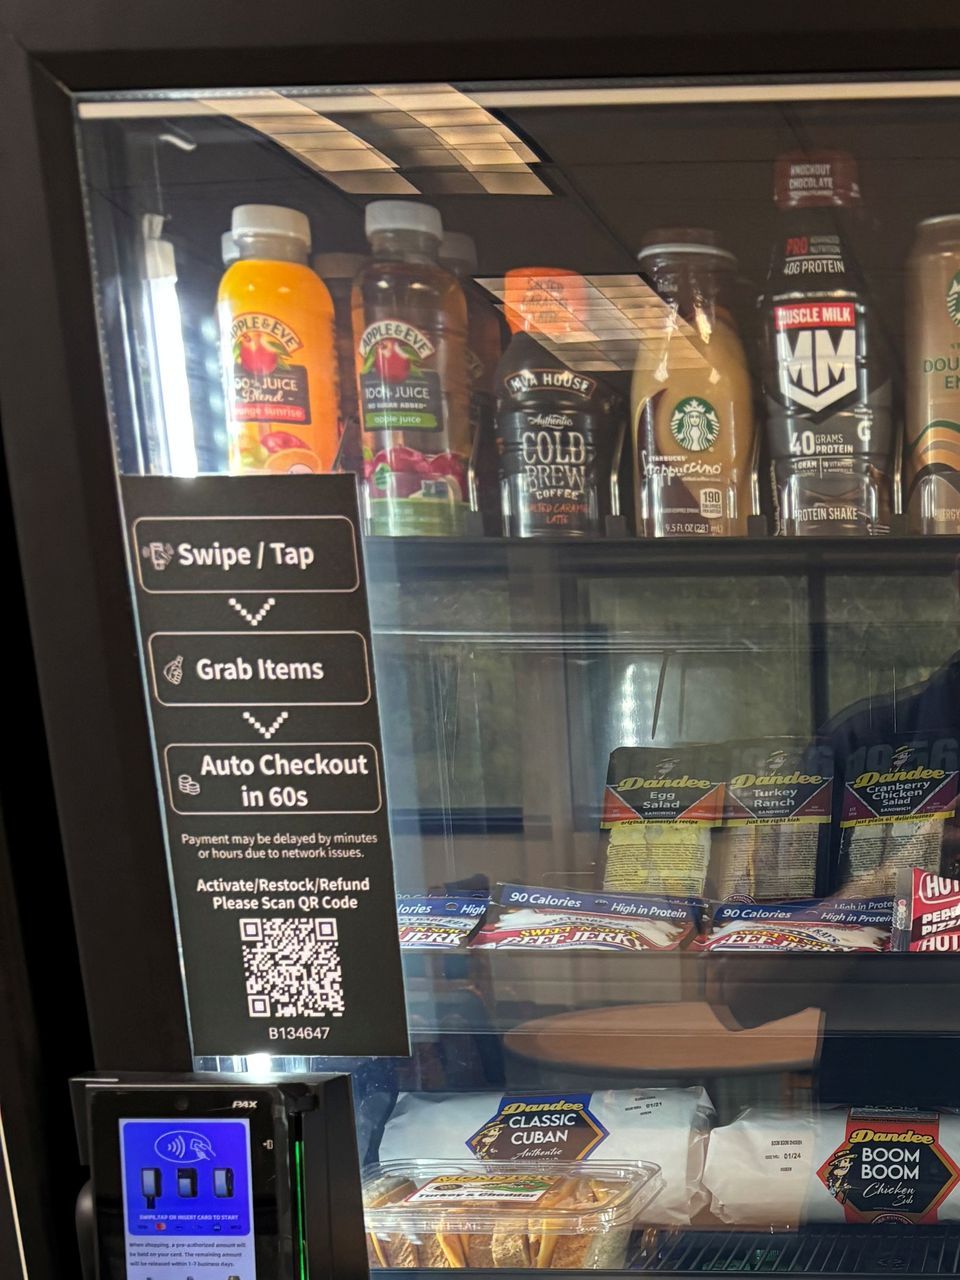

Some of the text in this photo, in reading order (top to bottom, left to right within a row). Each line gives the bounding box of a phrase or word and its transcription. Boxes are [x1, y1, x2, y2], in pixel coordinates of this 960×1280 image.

[788, 177, 834, 189] CHOCOLATE
[802, 260, 845, 274] PROTEIN
[778, 306, 852, 324] MUSCLE MILK
[394, 386, 430, 399] JUICE
[789, 430, 815, 456] 40
[815, 434, 844, 444] GRAMS
[521, 431, 586, 464] COLD
[815, 444, 854, 454] PROTEIN
[523, 464, 586, 494] BREW
[535, 488, 579, 501] COFFEE
[703, 490, 721, 503] 190
[828, 507, 859, 521] SHAKE
[178, 541, 314, 571] Swipe / Tap
[196, 658, 324, 681] Grab Items
[200, 753, 369, 777] Auto Checkout
[617, 775, 711, 791] Dandee
[730, 771, 824, 789] Dandee
[853, 765, 946, 789] Dandee
[753, 787, 799, 799] Turkey
[866, 781, 931, 794] Cranberry
[872, 789, 923, 800] Chicken
[241, 785, 309, 807] in 60s
[650, 791, 675, 802] Egg
[753, 797, 796, 808] Ranch
[882, 796, 911, 806] Salad
[643, 800, 680, 810] Salad
[181, 832, 378, 847] Payment may be delayed by minutes
[198, 847, 365, 859] or hours due to network issues.
[196, 877, 370, 893] Activate/Restock/Refund
[212, 896, 359, 911] Please Scan QR Code
[460, 904, 486, 917] High
[509, 892, 687, 919] 90 Calories High in Protein
[722, 909, 893, 923] 90 Calories High in Protein
[268, 1026, 331, 1040] B134647
[231, 1100, 259, 1110] PAX
[501, 1099, 585, 1116] Dandee
[508, 1113, 577, 1129] CLASSIC
[511, 1130, 569, 1145] CUBAN
[848, 1129, 935, 1145] Dandee
[783, 1152, 802, 1160] 01/24
[861, 1147, 920, 1163] BOOM
[861, 1164, 920, 1181] BOOM
[862, 1181, 916, 1199] Chicken
